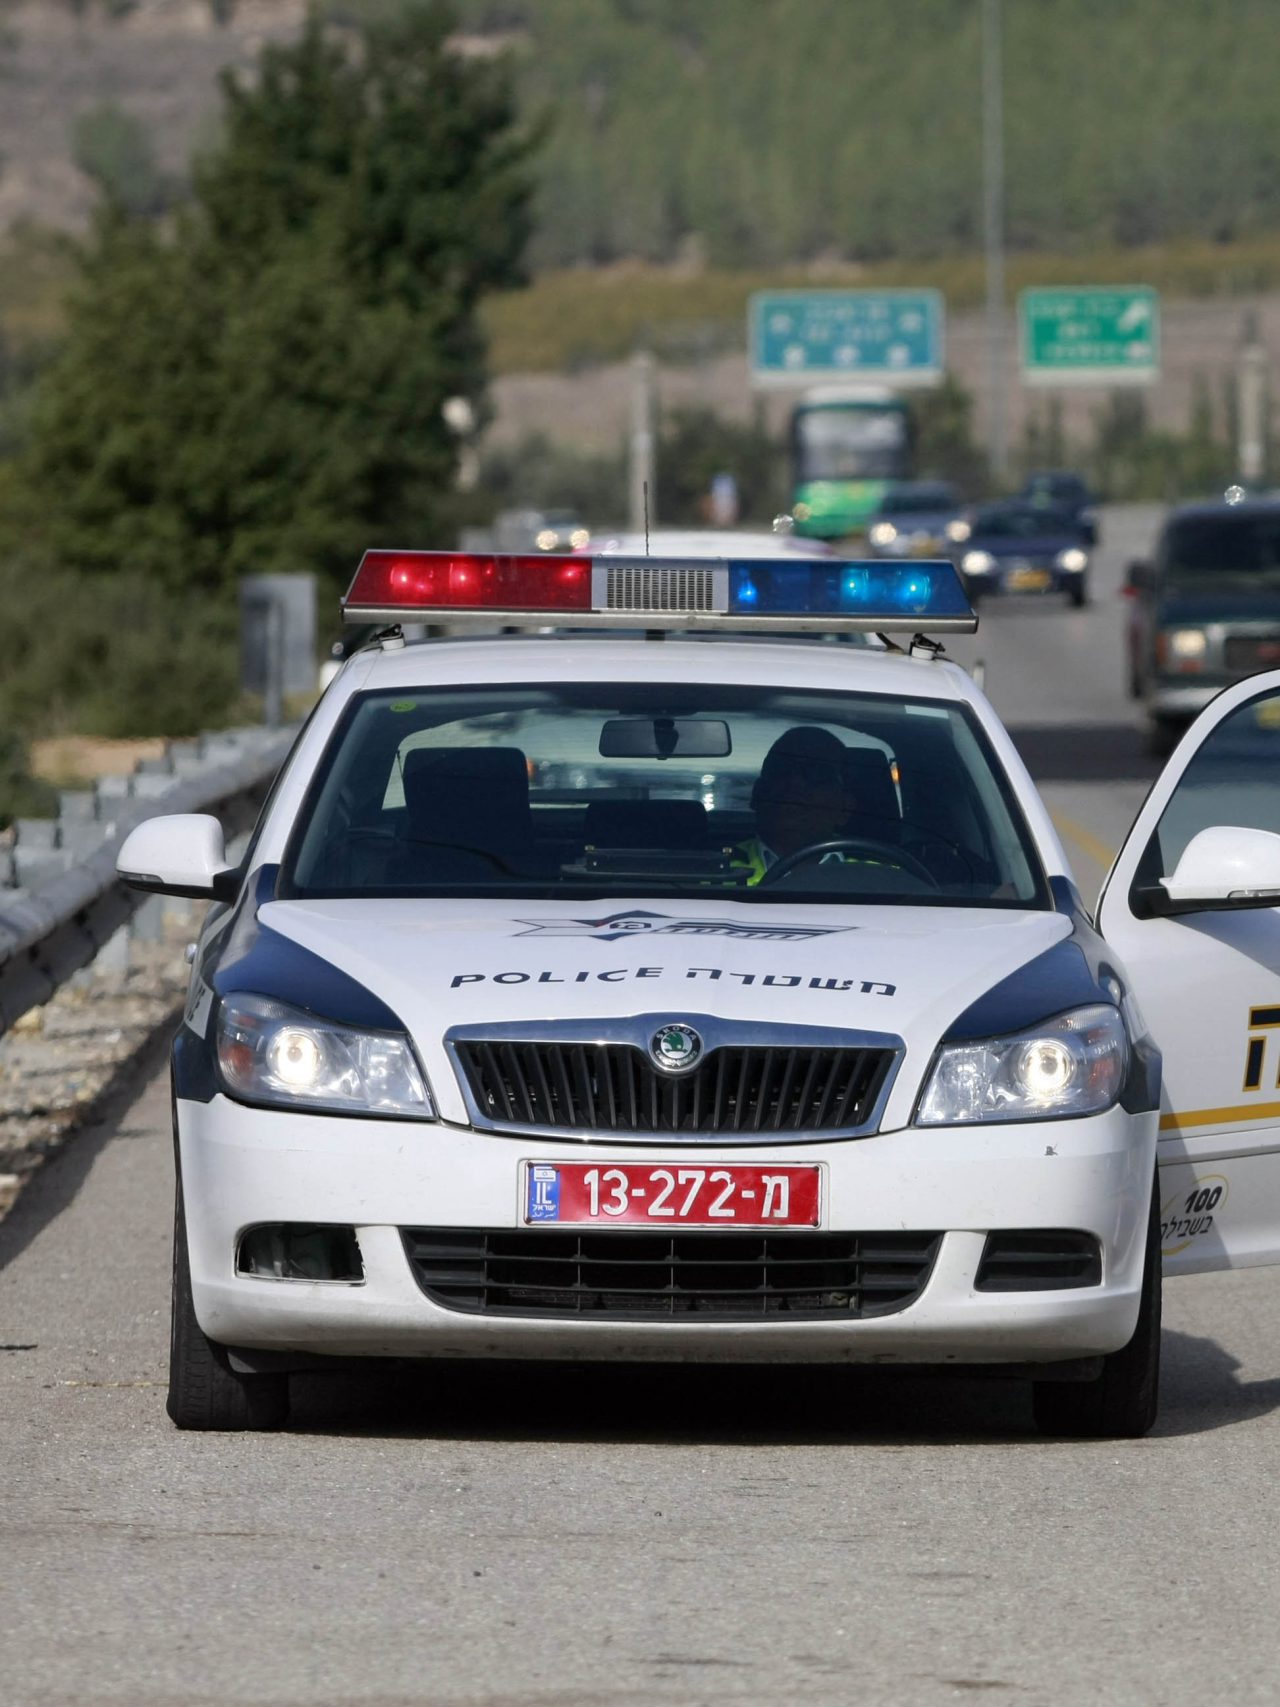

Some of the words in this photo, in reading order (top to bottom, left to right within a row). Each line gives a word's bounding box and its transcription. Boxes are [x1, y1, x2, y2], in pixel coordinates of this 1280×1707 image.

[450, 967, 664, 988] POLICE
[686, 967, 897, 996] משטרה
[536, 1182, 552, 1204] IL
[1184, 1186, 1223, 1214] 100
